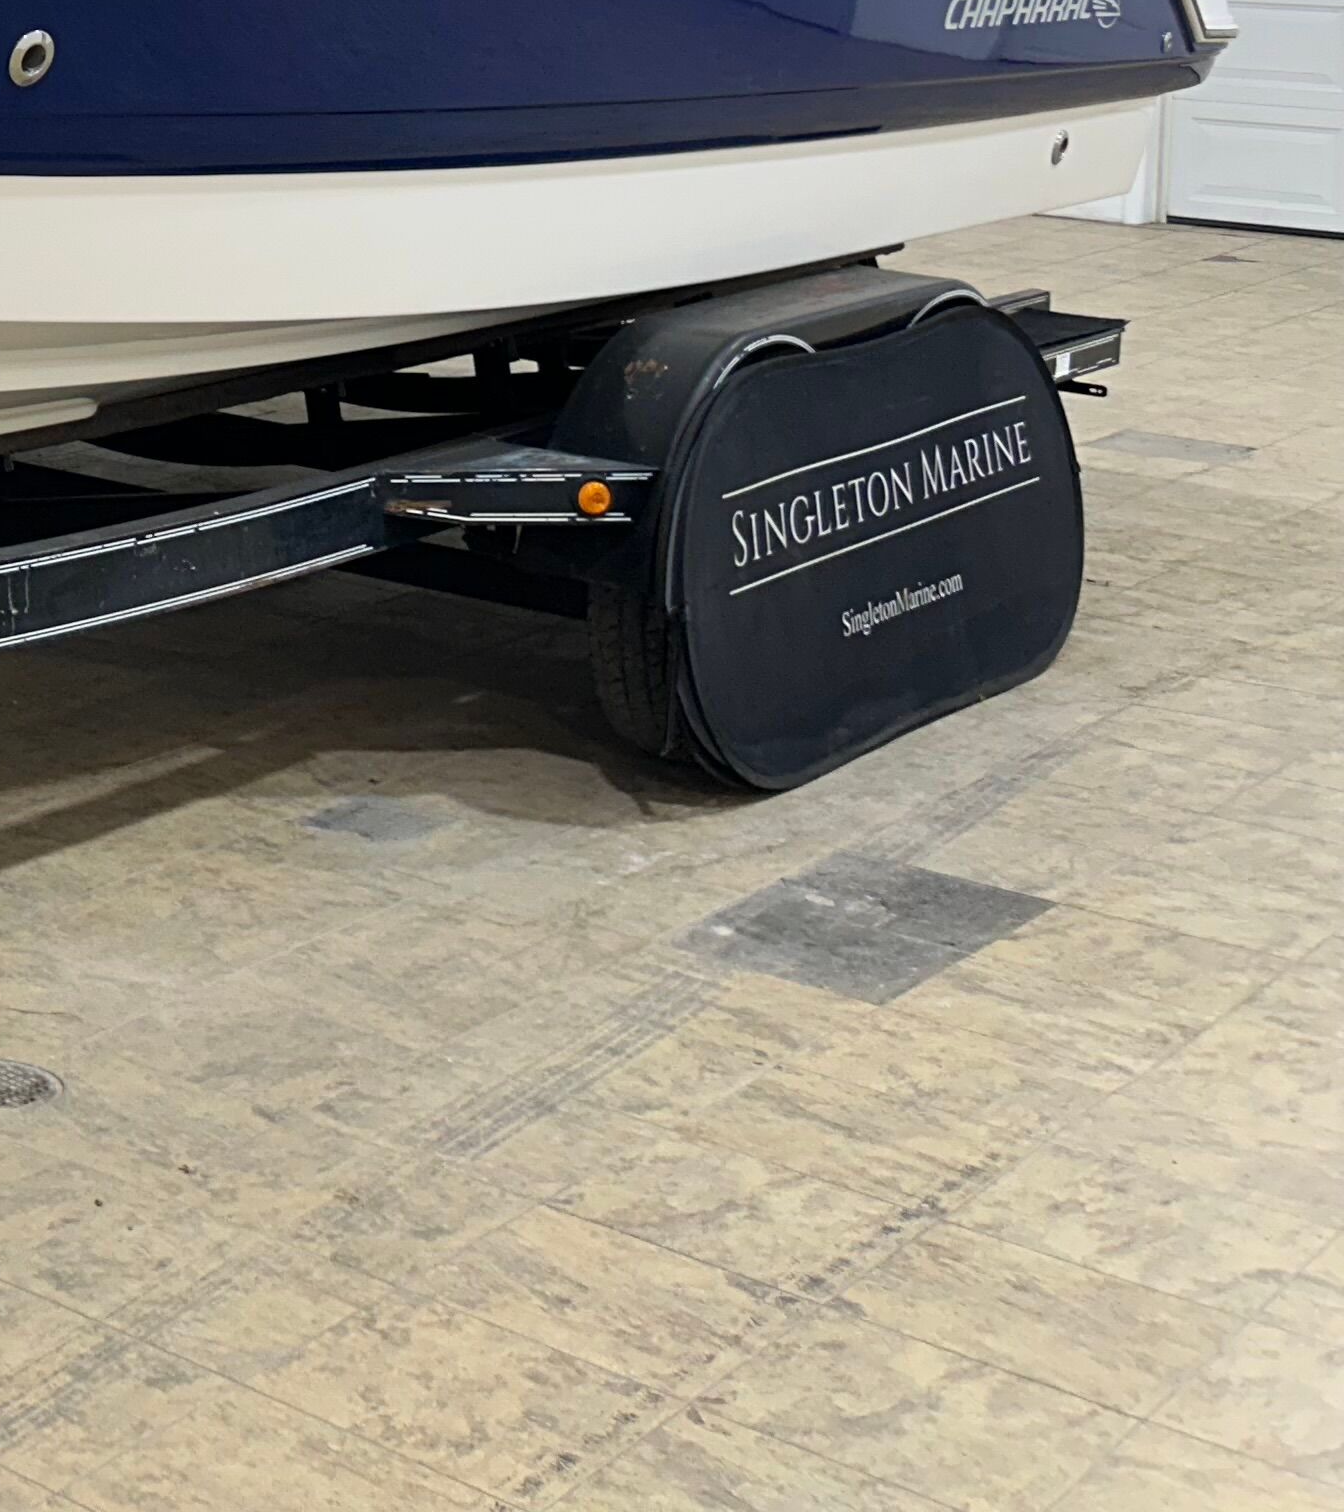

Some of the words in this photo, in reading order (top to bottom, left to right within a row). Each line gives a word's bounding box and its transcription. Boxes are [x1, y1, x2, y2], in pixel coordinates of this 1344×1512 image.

[731, 461, 914, 568] SINGLETON
[920, 421, 1032, 500] MARINE
[841, 573, 964, 637] SingletonMarine.com
